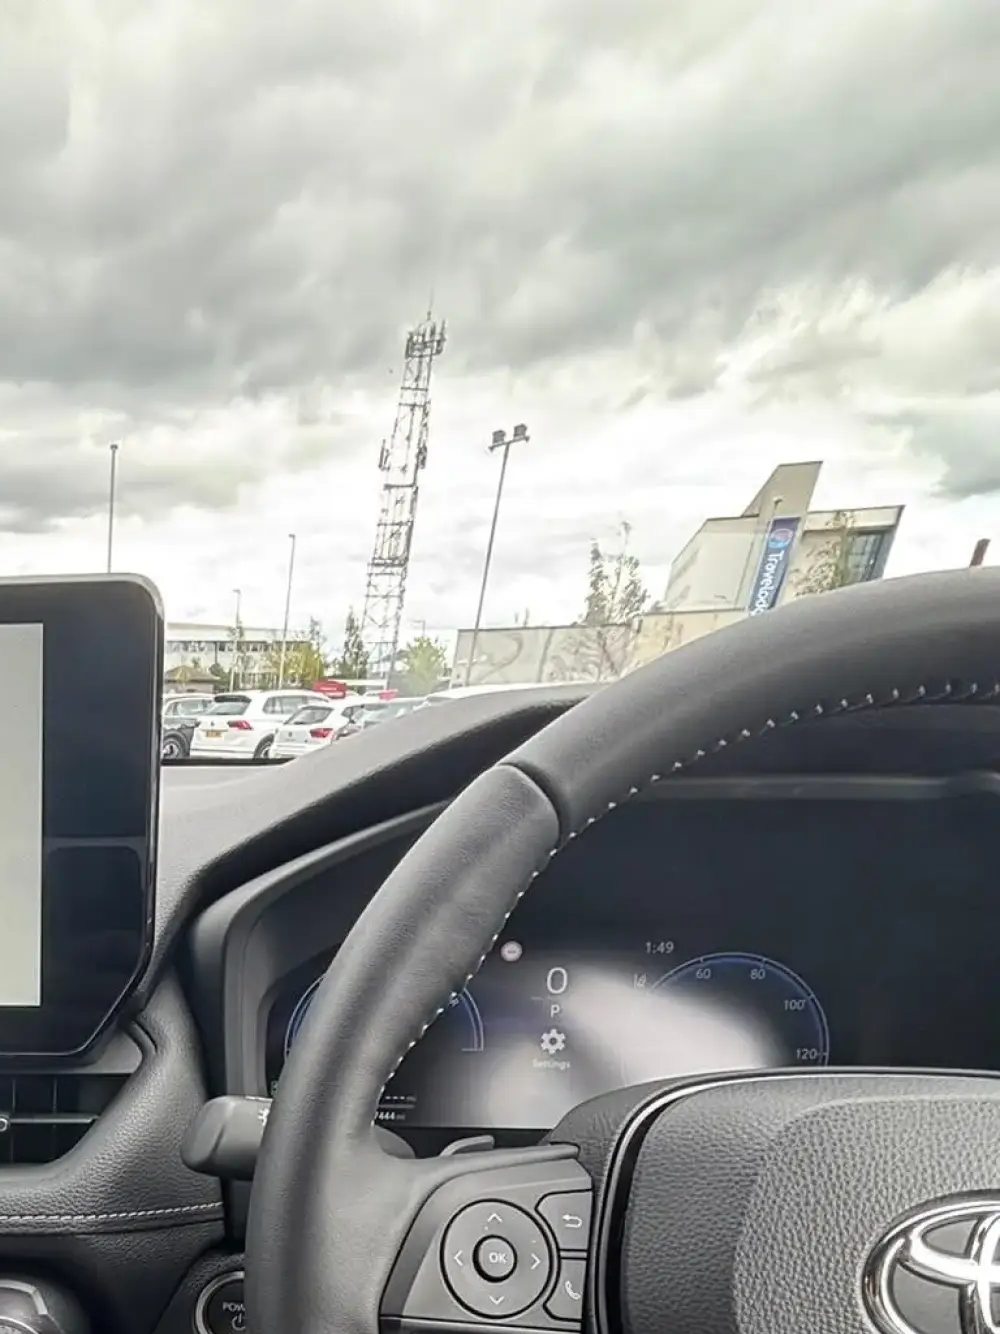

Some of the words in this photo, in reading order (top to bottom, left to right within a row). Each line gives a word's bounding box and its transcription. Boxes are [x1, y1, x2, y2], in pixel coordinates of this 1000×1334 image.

[751, 549, 785, 616] Travelodg
[645, 941, 675, 955] 1:49
[696, 968, 712, 979] 60
[750, 968, 766, 980] 80
[546, 967, 568, 994] 0
[550, 1004, 560, 1018] P
[784, 999, 806, 1011] 100
[796, 1048, 818, 1060] 120
[532, 1058, 571, 1071] Settings
[489, 1251, 507, 1264] OK
[222, 1302, 246, 1312] POW
